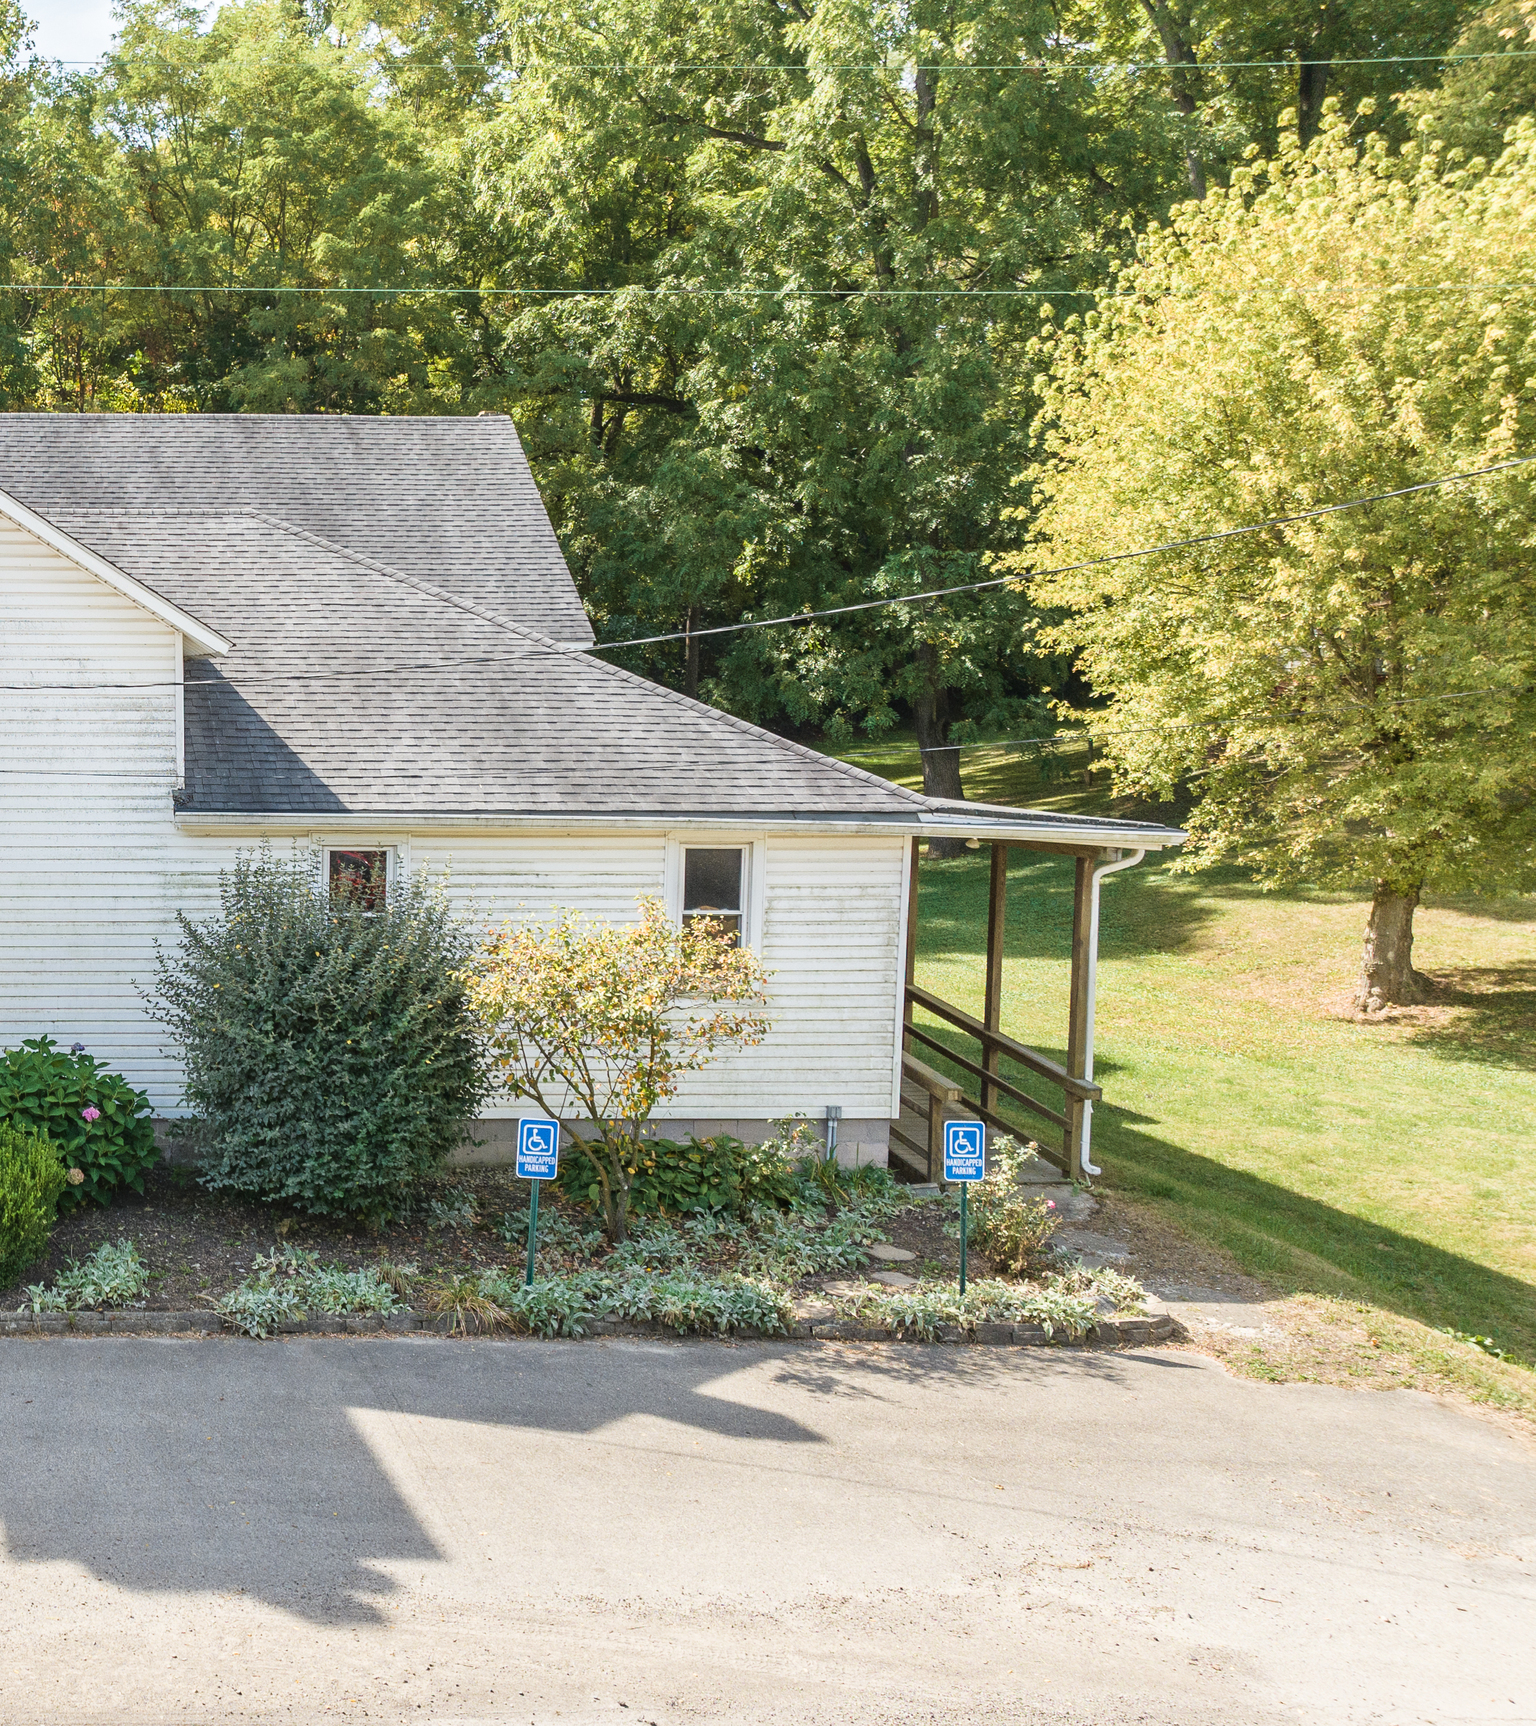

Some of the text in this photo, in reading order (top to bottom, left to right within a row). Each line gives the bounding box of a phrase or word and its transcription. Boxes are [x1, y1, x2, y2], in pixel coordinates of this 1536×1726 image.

[518, 1155, 556, 1165] HANDICAPPED
[946, 1158, 983, 1167] HANDICAPPED
[524, 1164, 549, 1173] PARKING
[952, 1167, 977, 1175] PARKING
